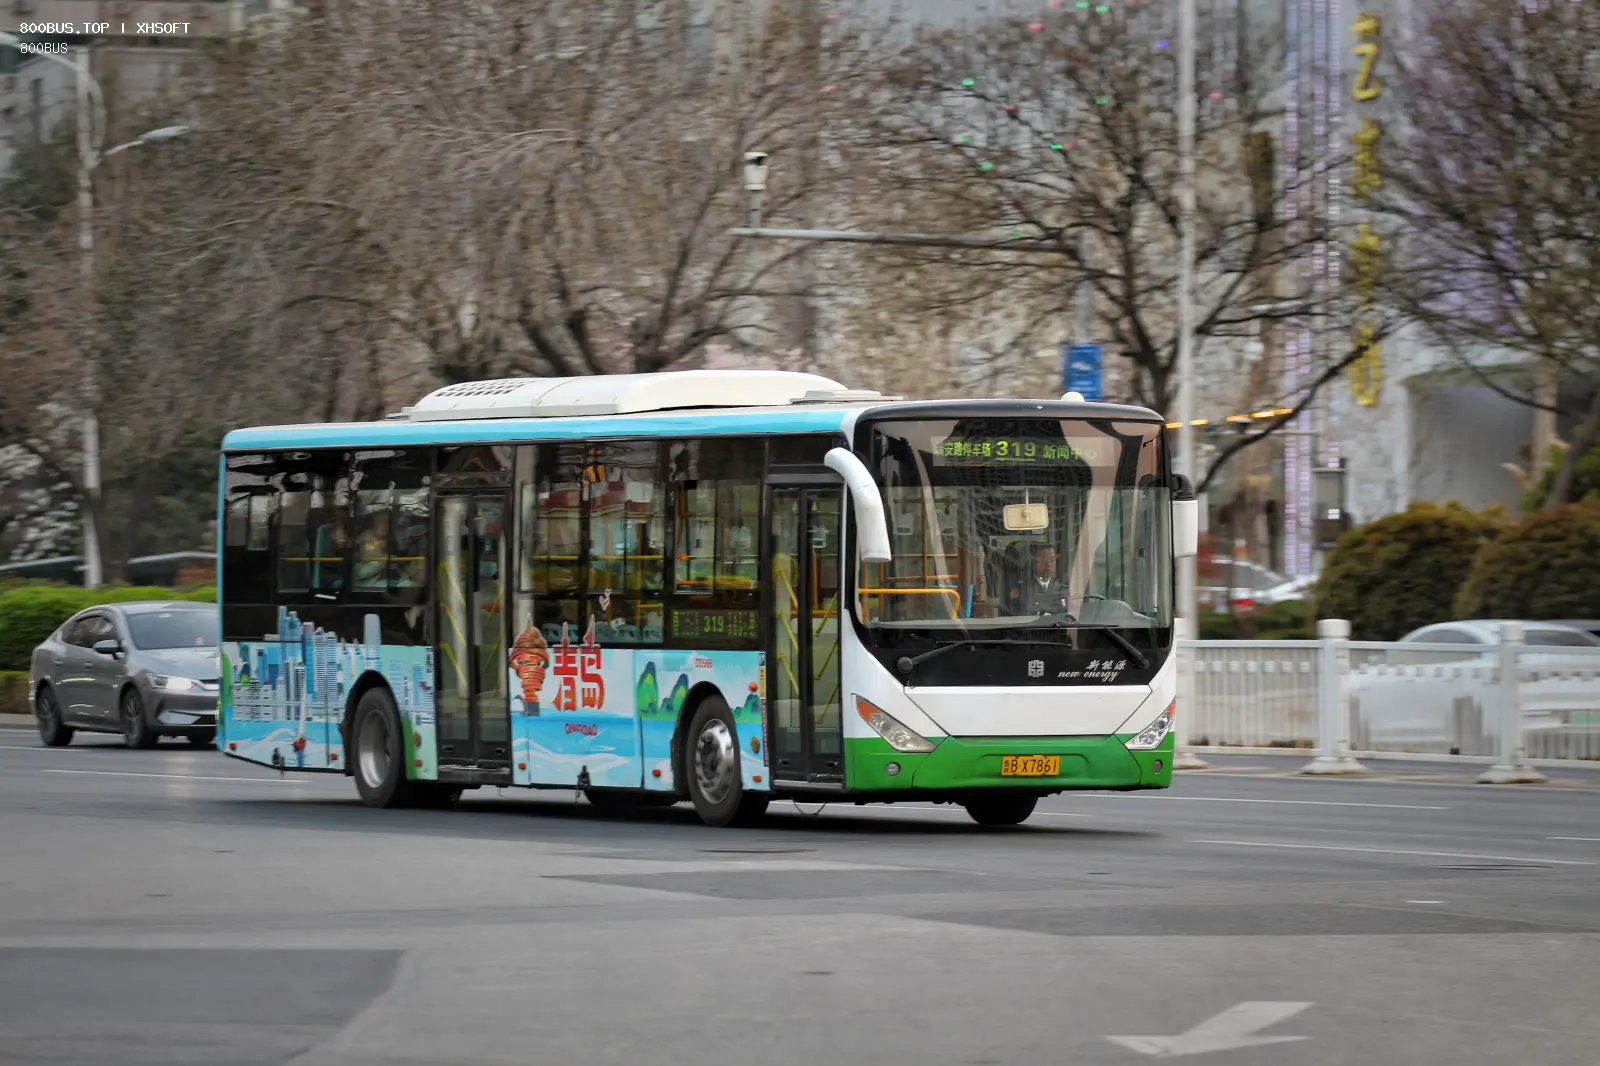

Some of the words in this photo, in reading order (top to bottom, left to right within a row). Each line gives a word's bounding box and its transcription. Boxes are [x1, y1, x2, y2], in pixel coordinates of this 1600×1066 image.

[996, 440, 1037, 457] 319
[1043, 443, 1098, 460] 新闻中心
[703, 615, 724, 633] 319
[1086, 660, 1127, 671] 新能源
[1083, 671, 1120, 682] energy
